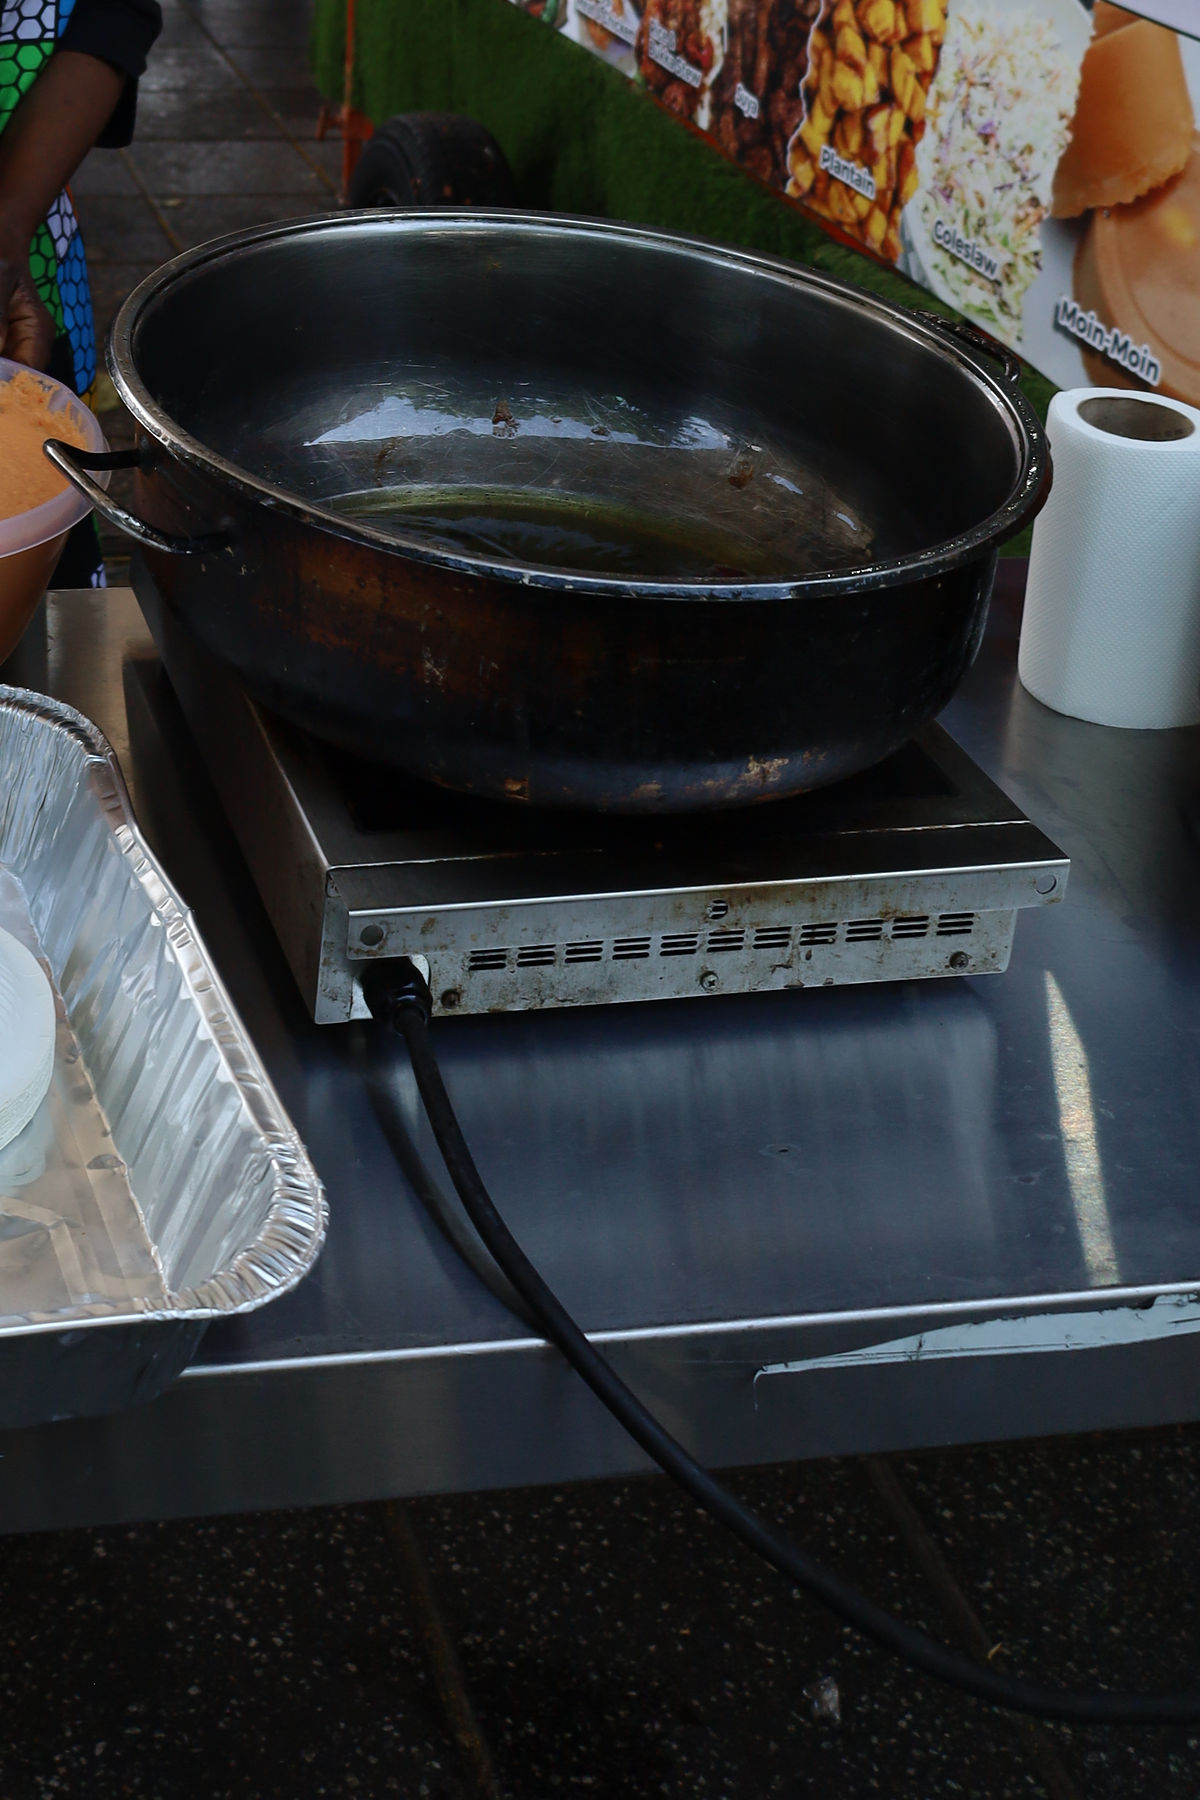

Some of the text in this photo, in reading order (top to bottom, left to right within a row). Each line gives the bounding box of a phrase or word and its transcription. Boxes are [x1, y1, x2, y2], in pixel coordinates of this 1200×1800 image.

[821, 146, 876, 199] Plantain
[933, 219, 1000, 280] Coleslaw
[1059, 297, 1161, 386] Moin-Moin
